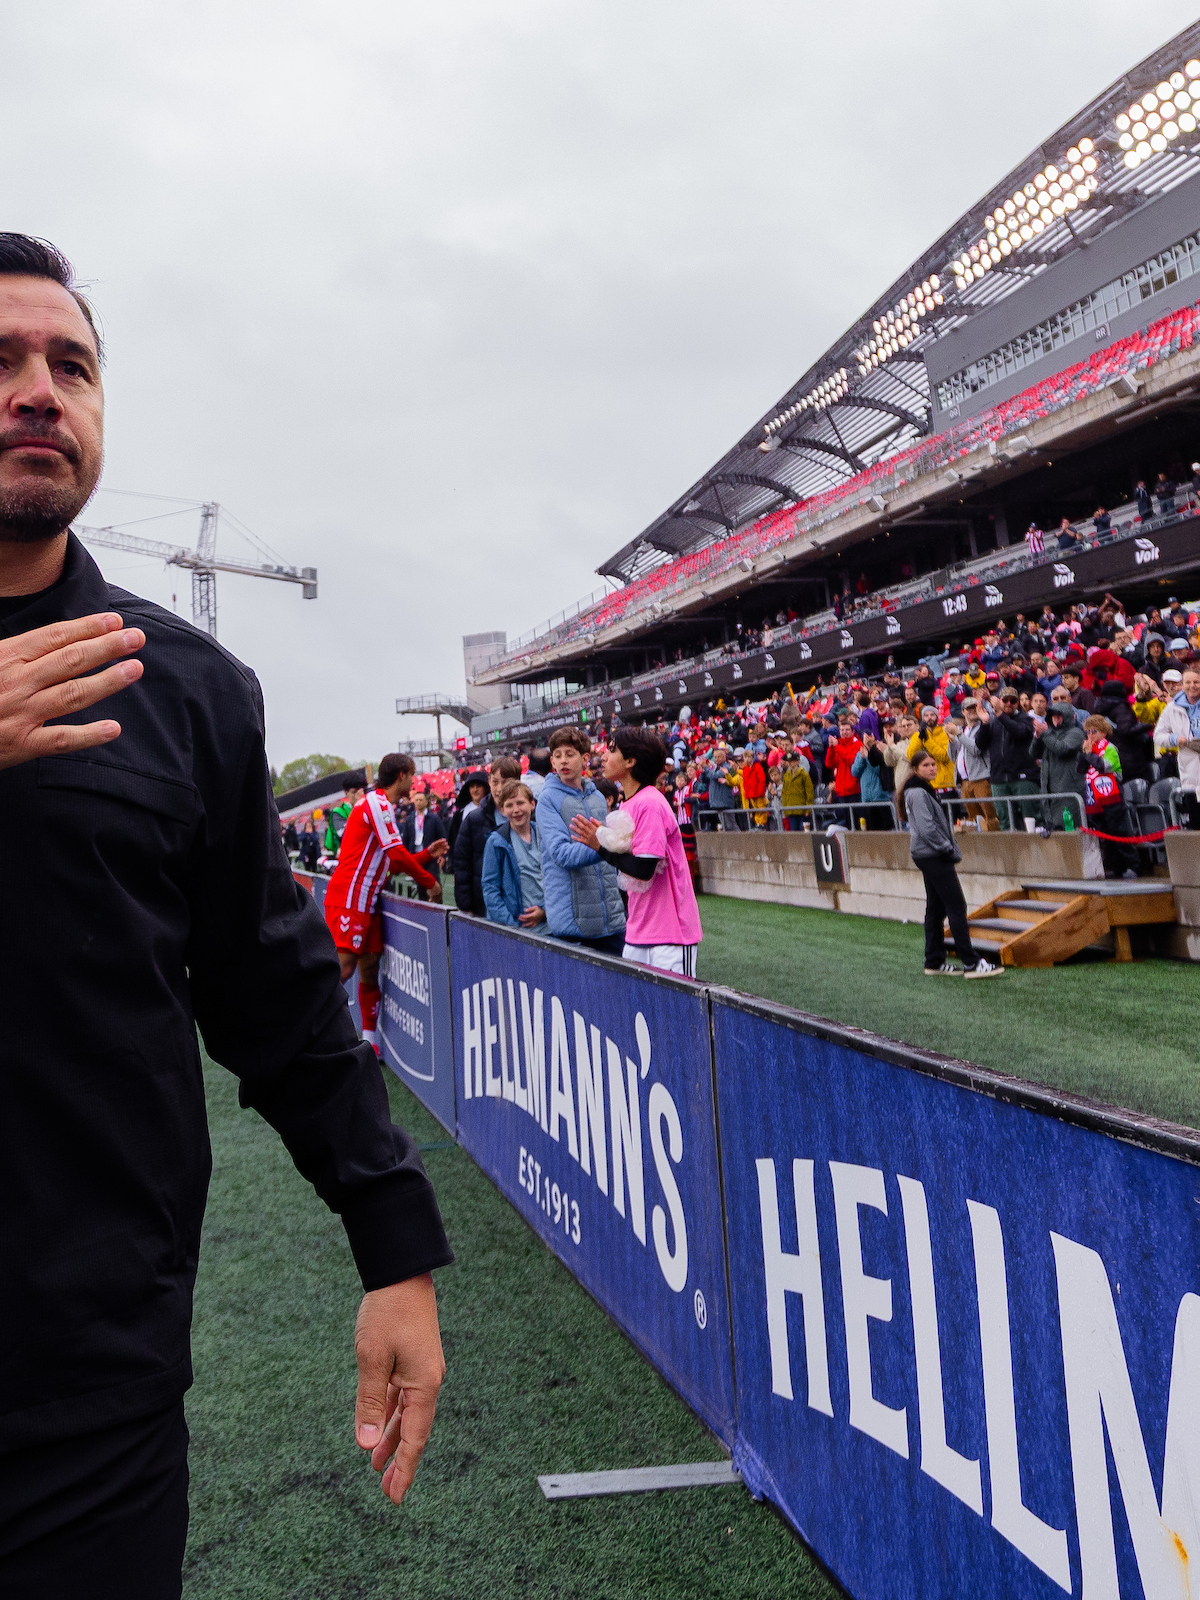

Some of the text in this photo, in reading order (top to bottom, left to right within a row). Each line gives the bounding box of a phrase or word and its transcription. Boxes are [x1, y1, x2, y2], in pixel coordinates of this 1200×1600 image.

[942, 594, 968, 616] 12:43
[820, 843, 833, 873] U
[461, 976, 689, 1293] HELLMANN'S
